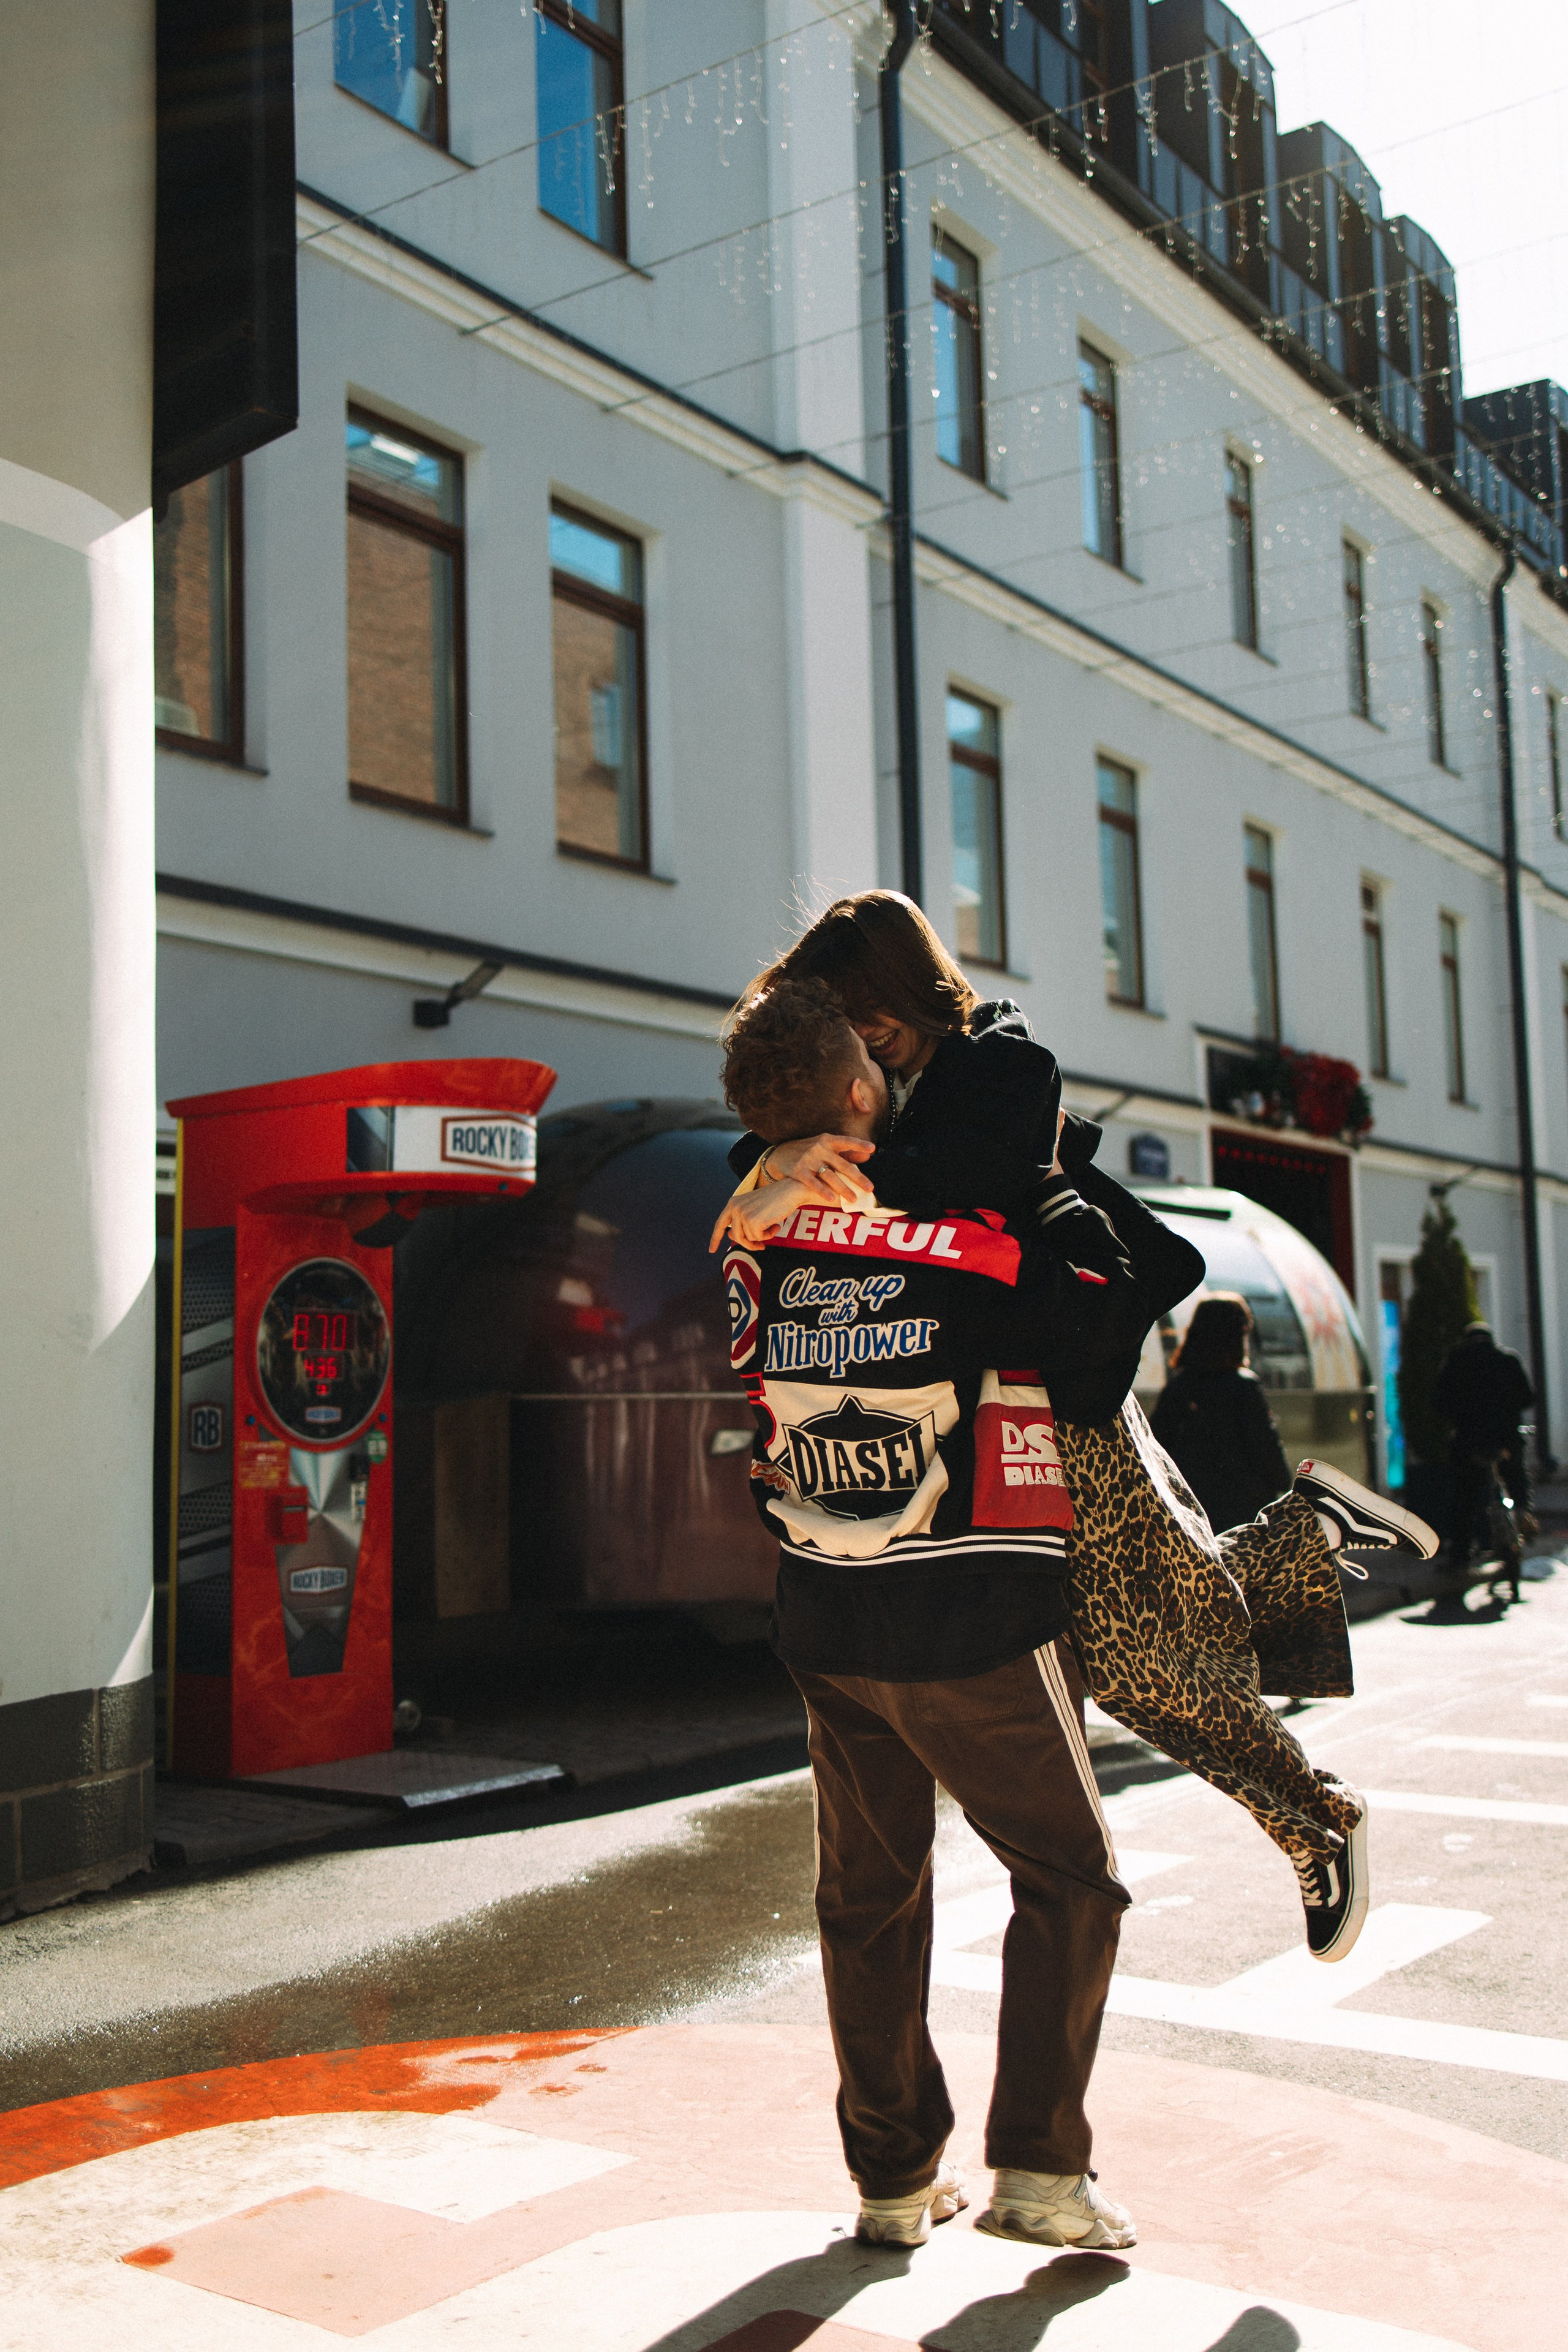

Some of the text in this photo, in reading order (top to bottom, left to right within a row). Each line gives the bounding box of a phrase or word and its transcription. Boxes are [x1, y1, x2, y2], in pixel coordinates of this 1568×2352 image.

[452, 1126, 508, 1159] ROCKY
[779, 1266, 905, 1311] Clean up
[818, 1300, 859, 1326] with
[293, 1314, 347, 1351] 870
[764, 1318, 940, 1378] Nitropower
[194, 1410, 219, 1446] RB
